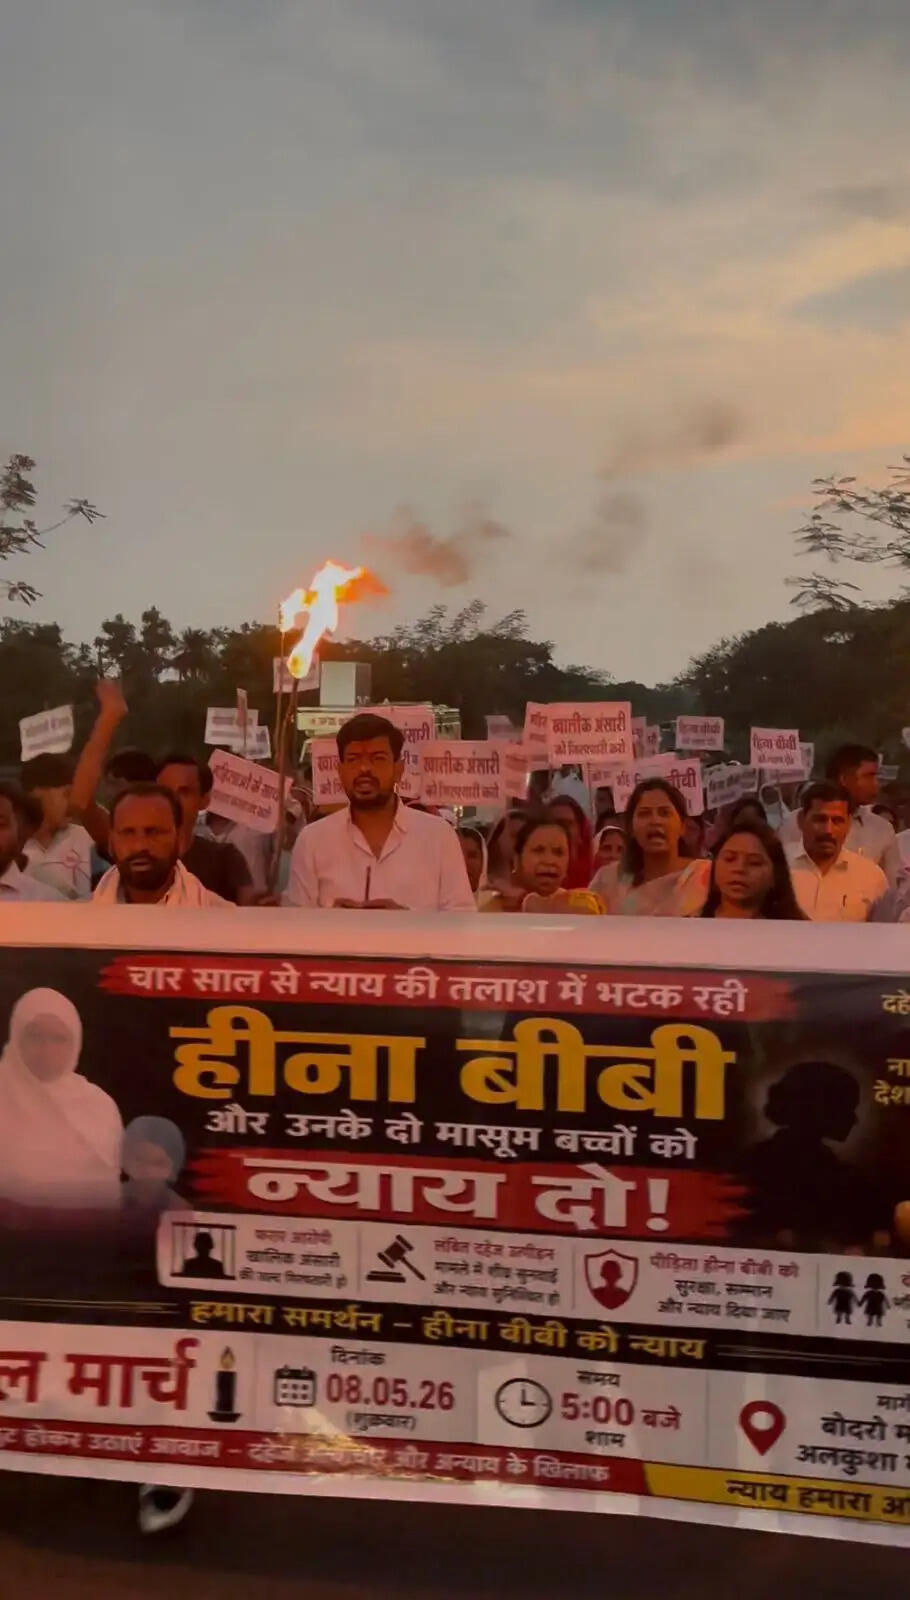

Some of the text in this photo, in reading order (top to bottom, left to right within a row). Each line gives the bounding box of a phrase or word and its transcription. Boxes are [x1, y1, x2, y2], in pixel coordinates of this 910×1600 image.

[127, 962, 748, 1015] चार साल से न्याय की तलाश में भटक रही
[168, 1005, 736, 1120] हीना बीबी
[205, 1103, 698, 1159] और उनके दो मासूम बच्चों को
[243, 1158, 670, 1231] न्याय दो!
[703, 1256, 736, 1274] हीना
[739, 1259, 773, 1276] बीबी
[778, 1262, 799, 1278] को
[658, 1298, 683, 1314] और
[687, 1302, 721, 1316] न्याय
[190, 1301, 276, 1325] हमारा
[281, 1304, 384, 1332] समर्थन
[421, 1310, 489, 1341] हीना
[498, 1317, 568, 1348] बीबी
[575, 1325, 619, 1354] को
[628, 1335, 708, 1360] न्याय
[331, 1345, 386, 1366] दिनांक
[66, 1337, 200, 1411] मार्च
[576, 1369, 621, 1388] समय
[326, 1373, 454, 1412] 08.05.26
[346, 1411, 416, 1431] (शुक्रवार)
[561, 1392, 681, 1430] 5:00 बजे
[821, 1411, 888, 1441] बोदरो
[24, 1424, 82, 1449] होकर
[434, 1453, 501, 1475] अन्याय
[506, 1452, 528, 1475] के
[533, 1455, 610, 1483] खिलाफ
[585, 1430, 626, 1448] शाम
[796, 1445, 898, 1476] अलकुशा
[726, 1480, 790, 1502] न्याय
[796, 1487, 873, 1512] हमारा
